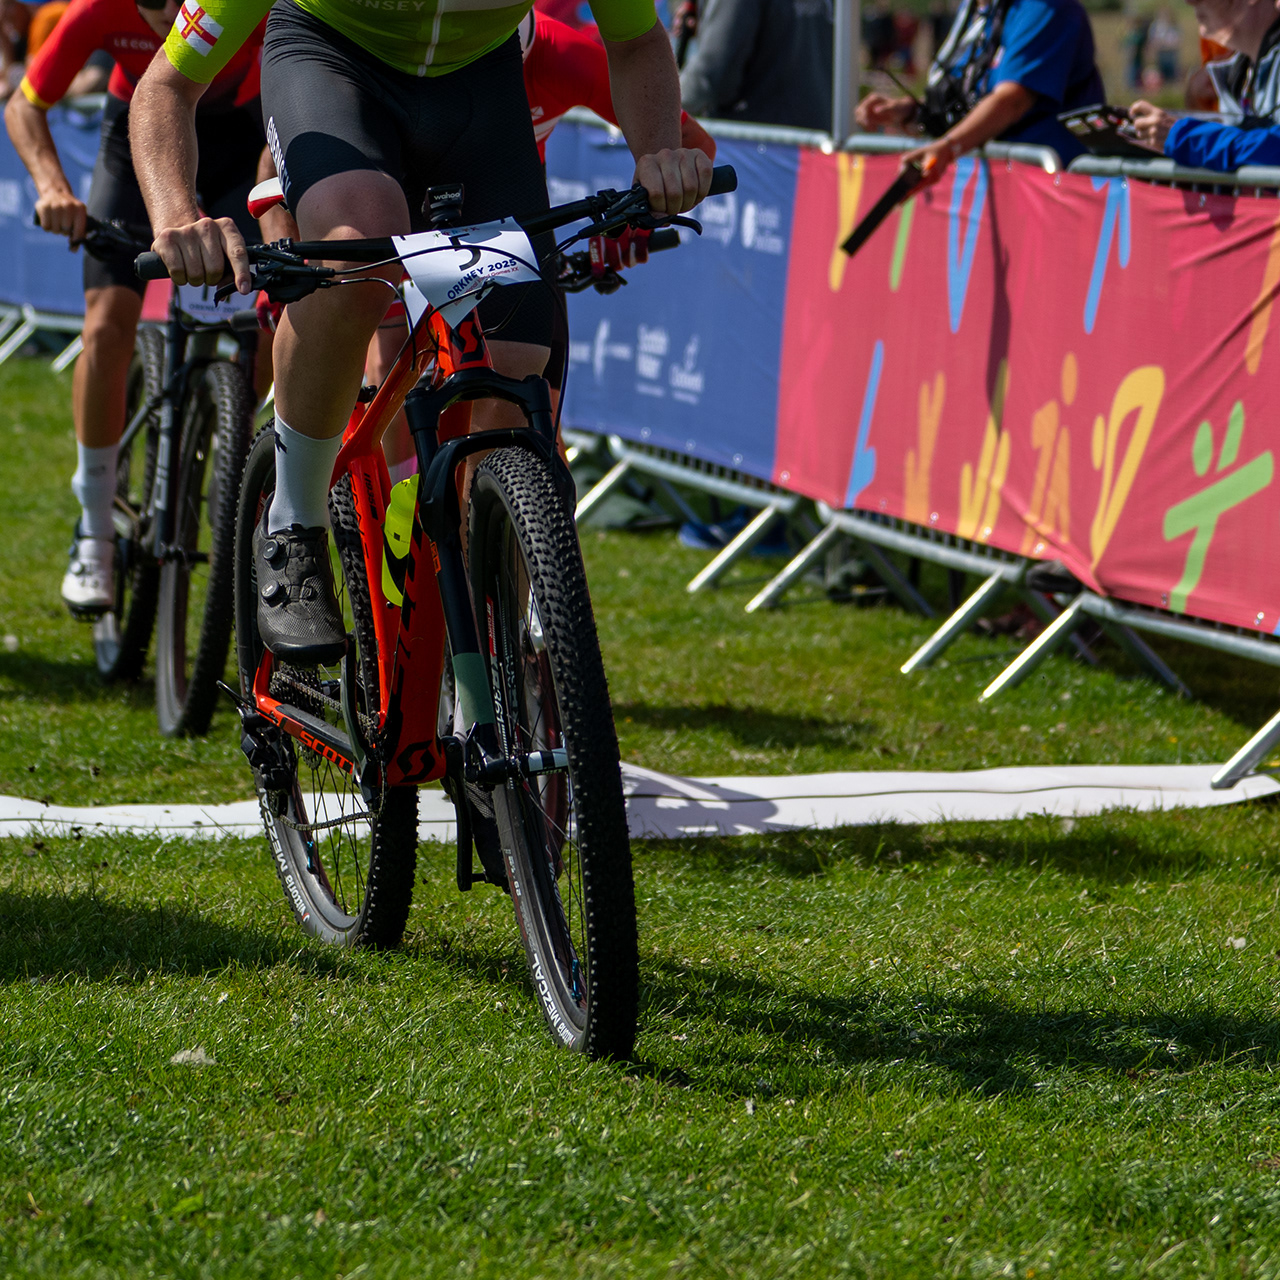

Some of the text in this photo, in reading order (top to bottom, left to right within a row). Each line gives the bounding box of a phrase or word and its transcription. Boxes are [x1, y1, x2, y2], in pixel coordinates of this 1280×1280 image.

[433, 191, 461, 201] wahoo
[447, 258, 517, 300] ORKNEY 2025
[531, 952, 562, 1027] MEZCAL
